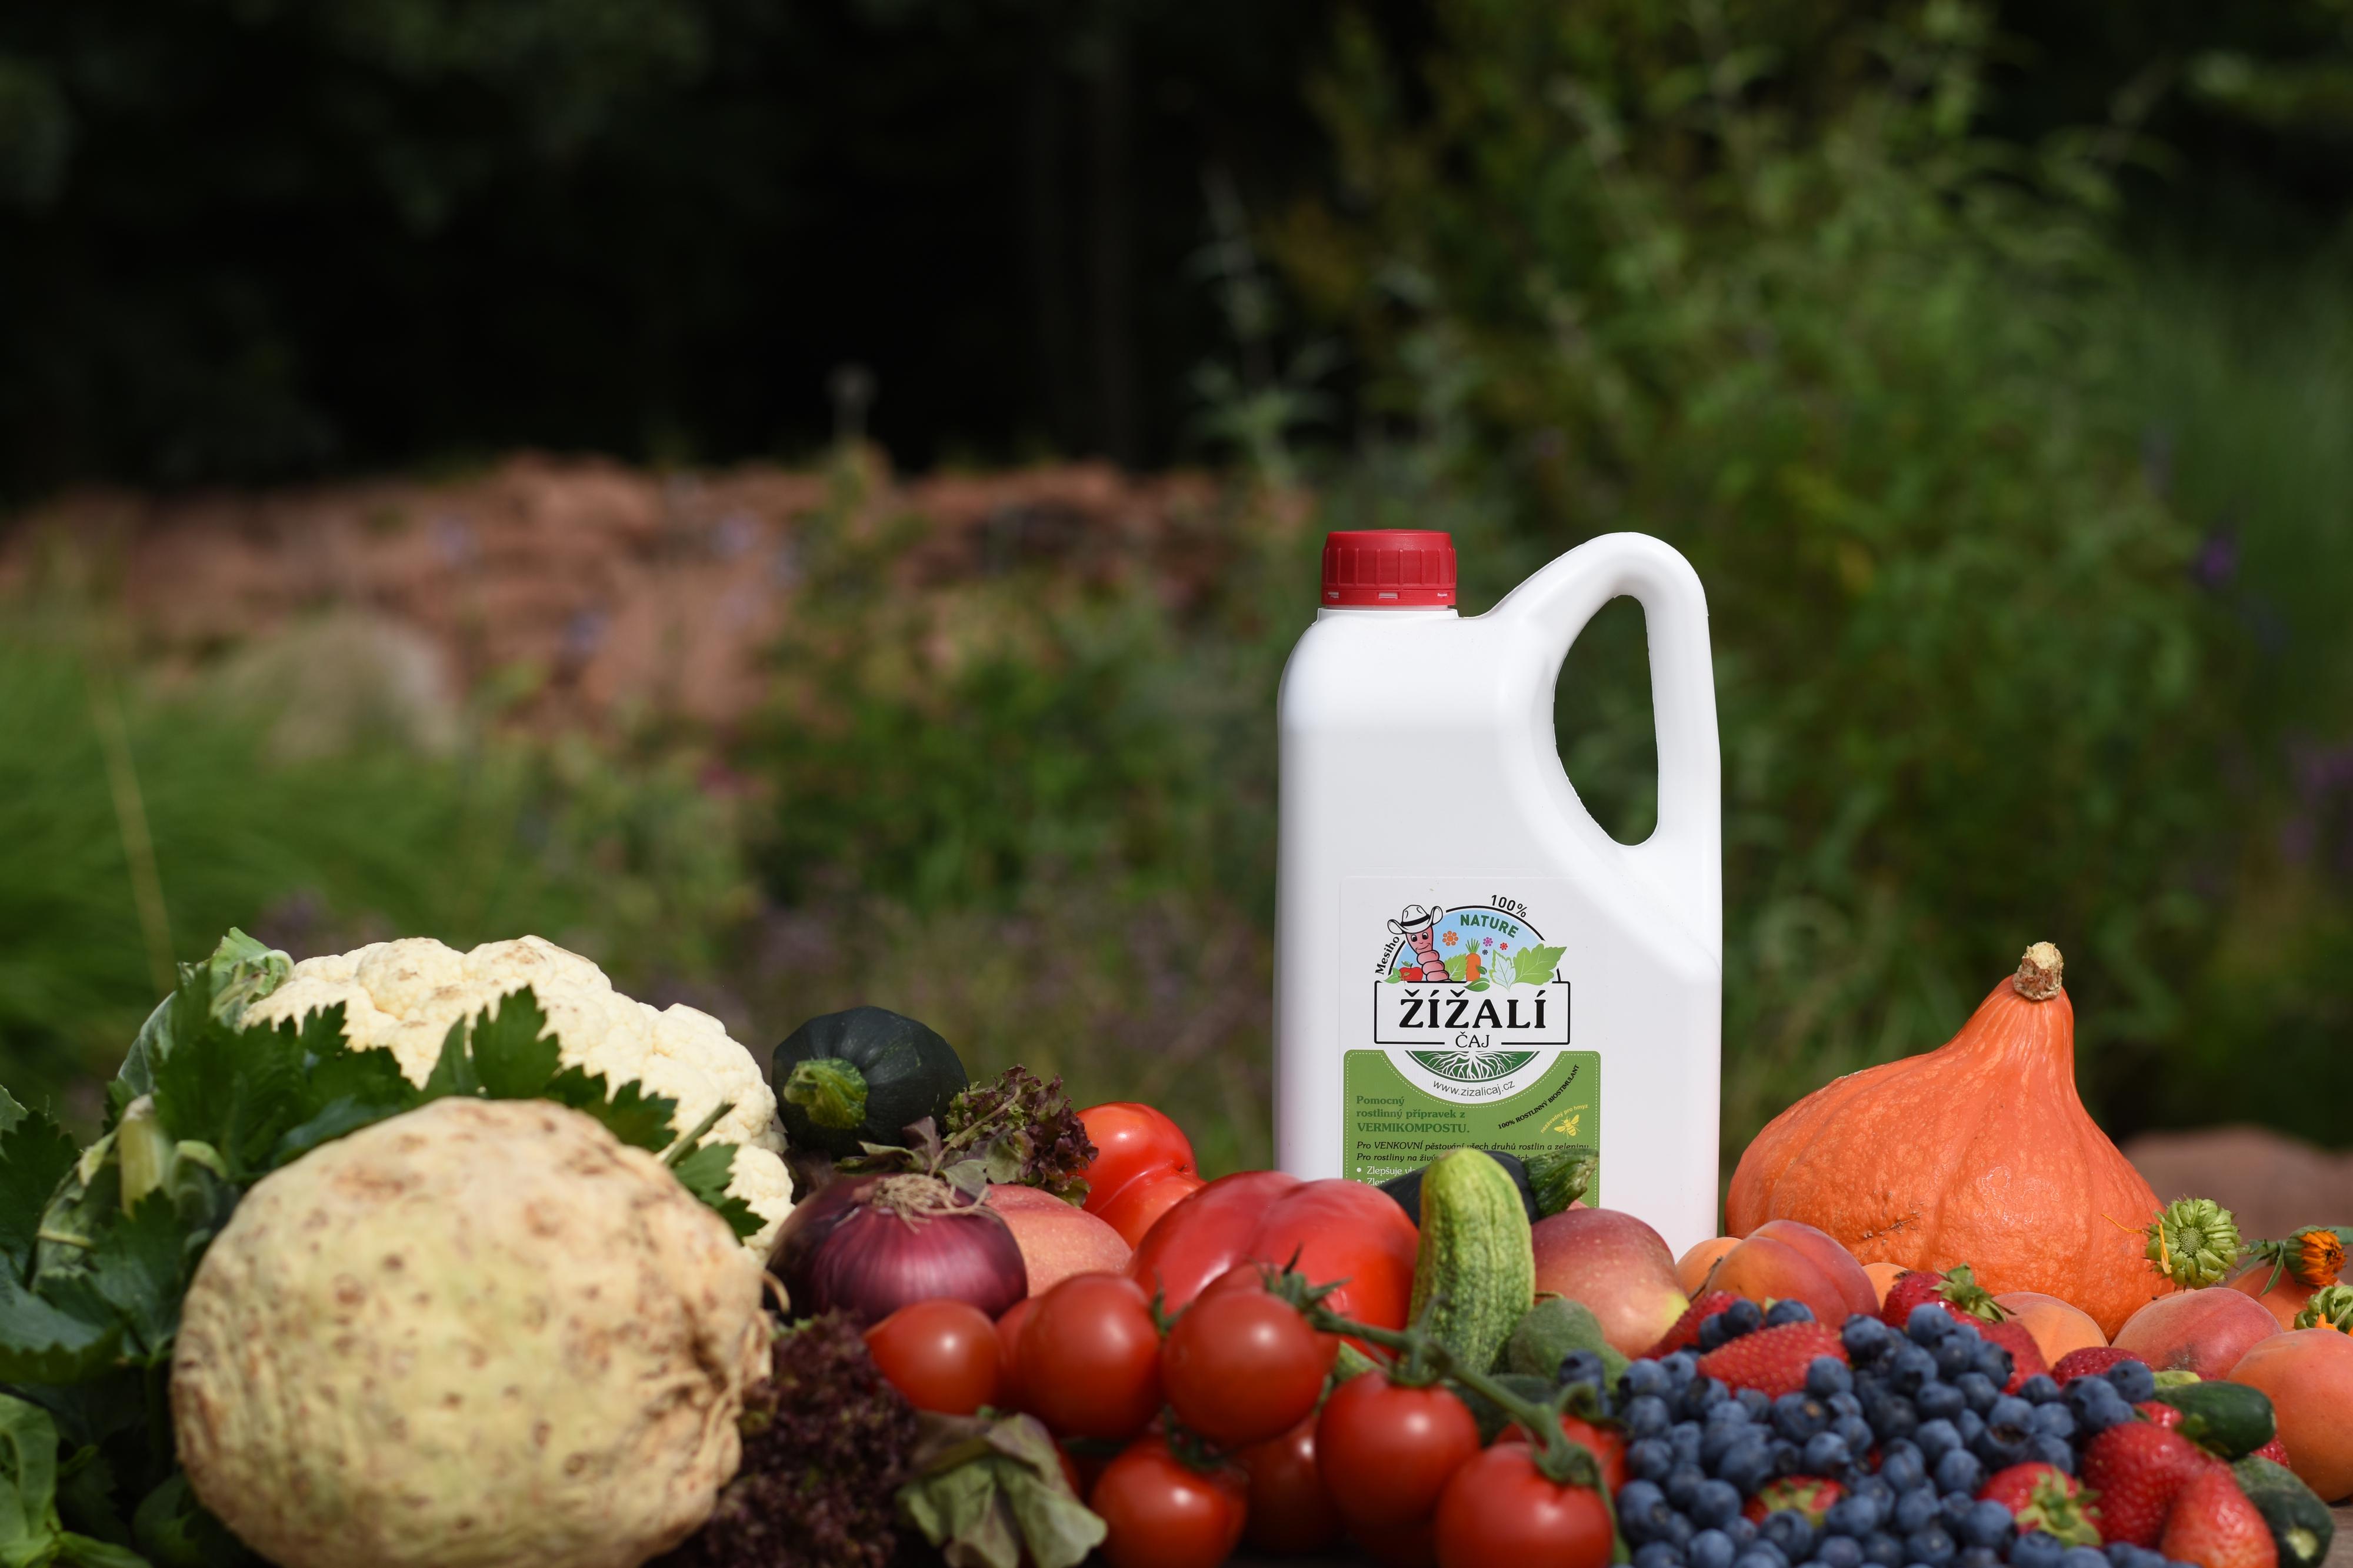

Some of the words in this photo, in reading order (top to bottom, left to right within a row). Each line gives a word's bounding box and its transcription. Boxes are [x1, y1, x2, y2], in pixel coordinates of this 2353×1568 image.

[1491, 895, 1528, 918] 100%
[1461, 914, 1519, 938] NATURE
[1375, 936, 1400, 975] Mesiho
[1399, 989, 1547, 1029] ŽÍŽALÍ
[1455, 1031, 1490, 1047] ČAJ
[1433, 1080, 1515, 1097] www.zizalicaj.cz
[1356, 1096, 1405, 1106] Pomocný
[1498, 1119, 1515, 1130] 100%
[1515, 1100, 1548, 1123] ROSTLINNÝ
[1547, 1064, 1580, 1103] BIOSTIMULANT
[1356, 1109, 1402, 1119] rostlinný
[1406, 1109, 1457, 1119] přípravek
[1357, 1122, 1470, 1133] VERMIKOMPOSTU.
[1540, 1112, 1564, 1134] nezávadný
[1357, 1141, 1371, 1149] Pro
[1374, 1140, 1424, 1149] VENKOVNÍ
[1425, 1143, 1465, 1151] pěstování
[1491, 1142, 1516, 1150] druhů
[1519, 1142, 1545, 1150] rostlin
[1374, 1153, 1405, 1163] rostliny
[1367, 1166, 1402, 1176] Zlepšuje
